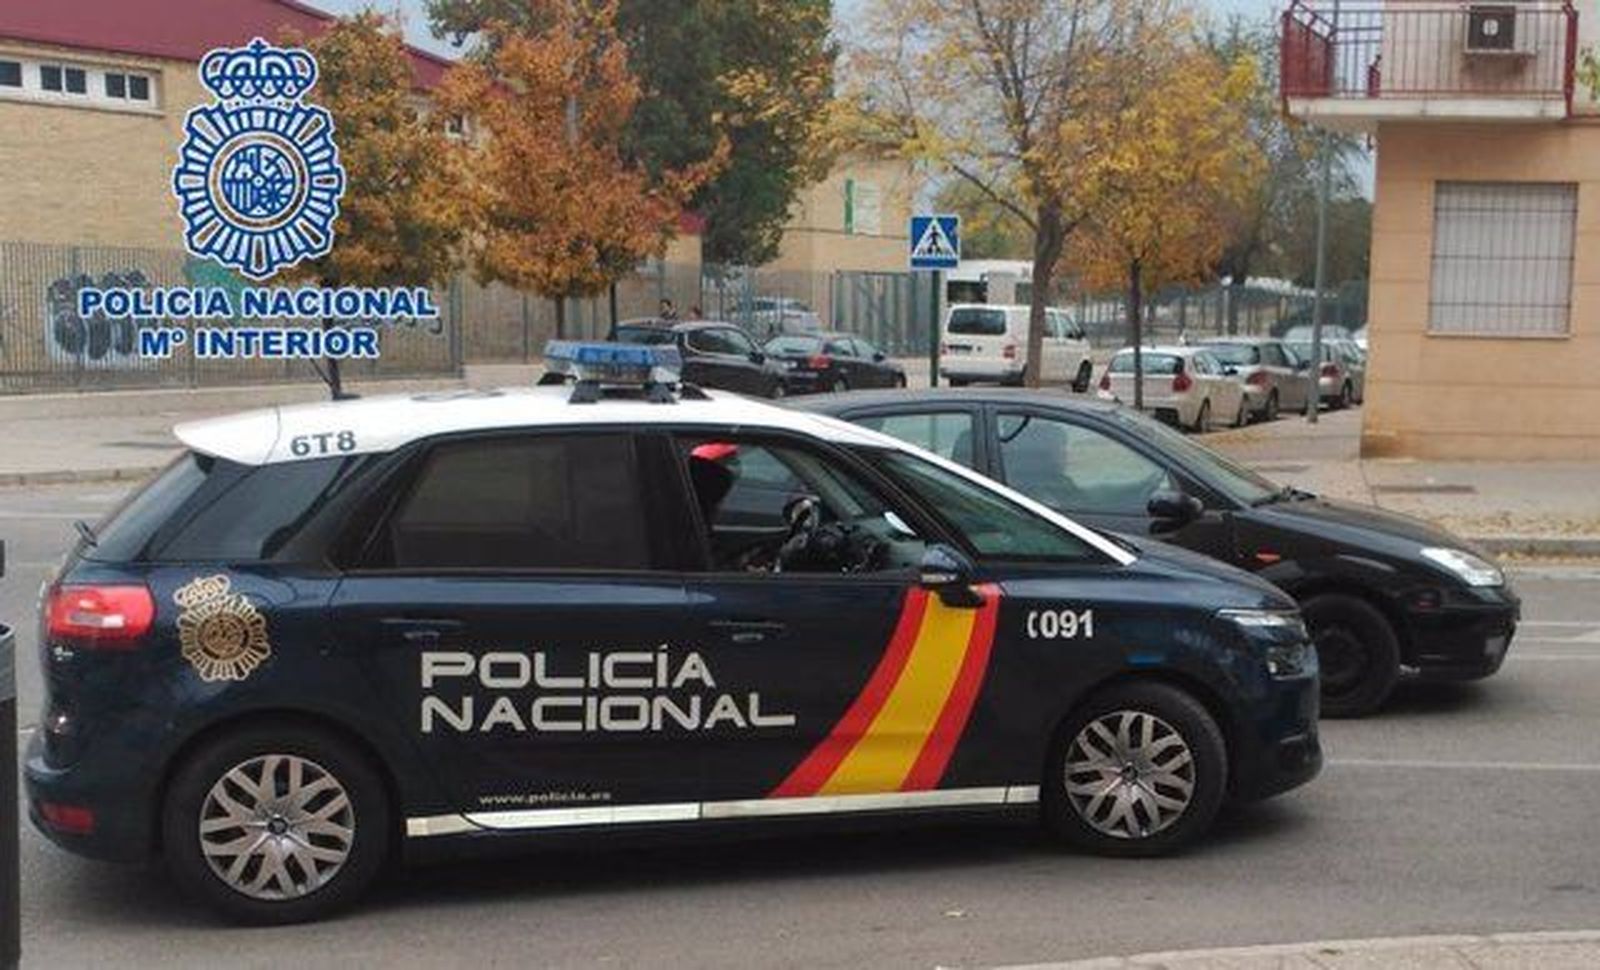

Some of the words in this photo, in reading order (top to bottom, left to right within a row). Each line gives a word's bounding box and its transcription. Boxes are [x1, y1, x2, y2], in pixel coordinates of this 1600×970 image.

[290, 431, 357, 457] 6T8
[421, 644, 715, 688] POLICÍA
[421, 692, 796, 733] NACIONAL
